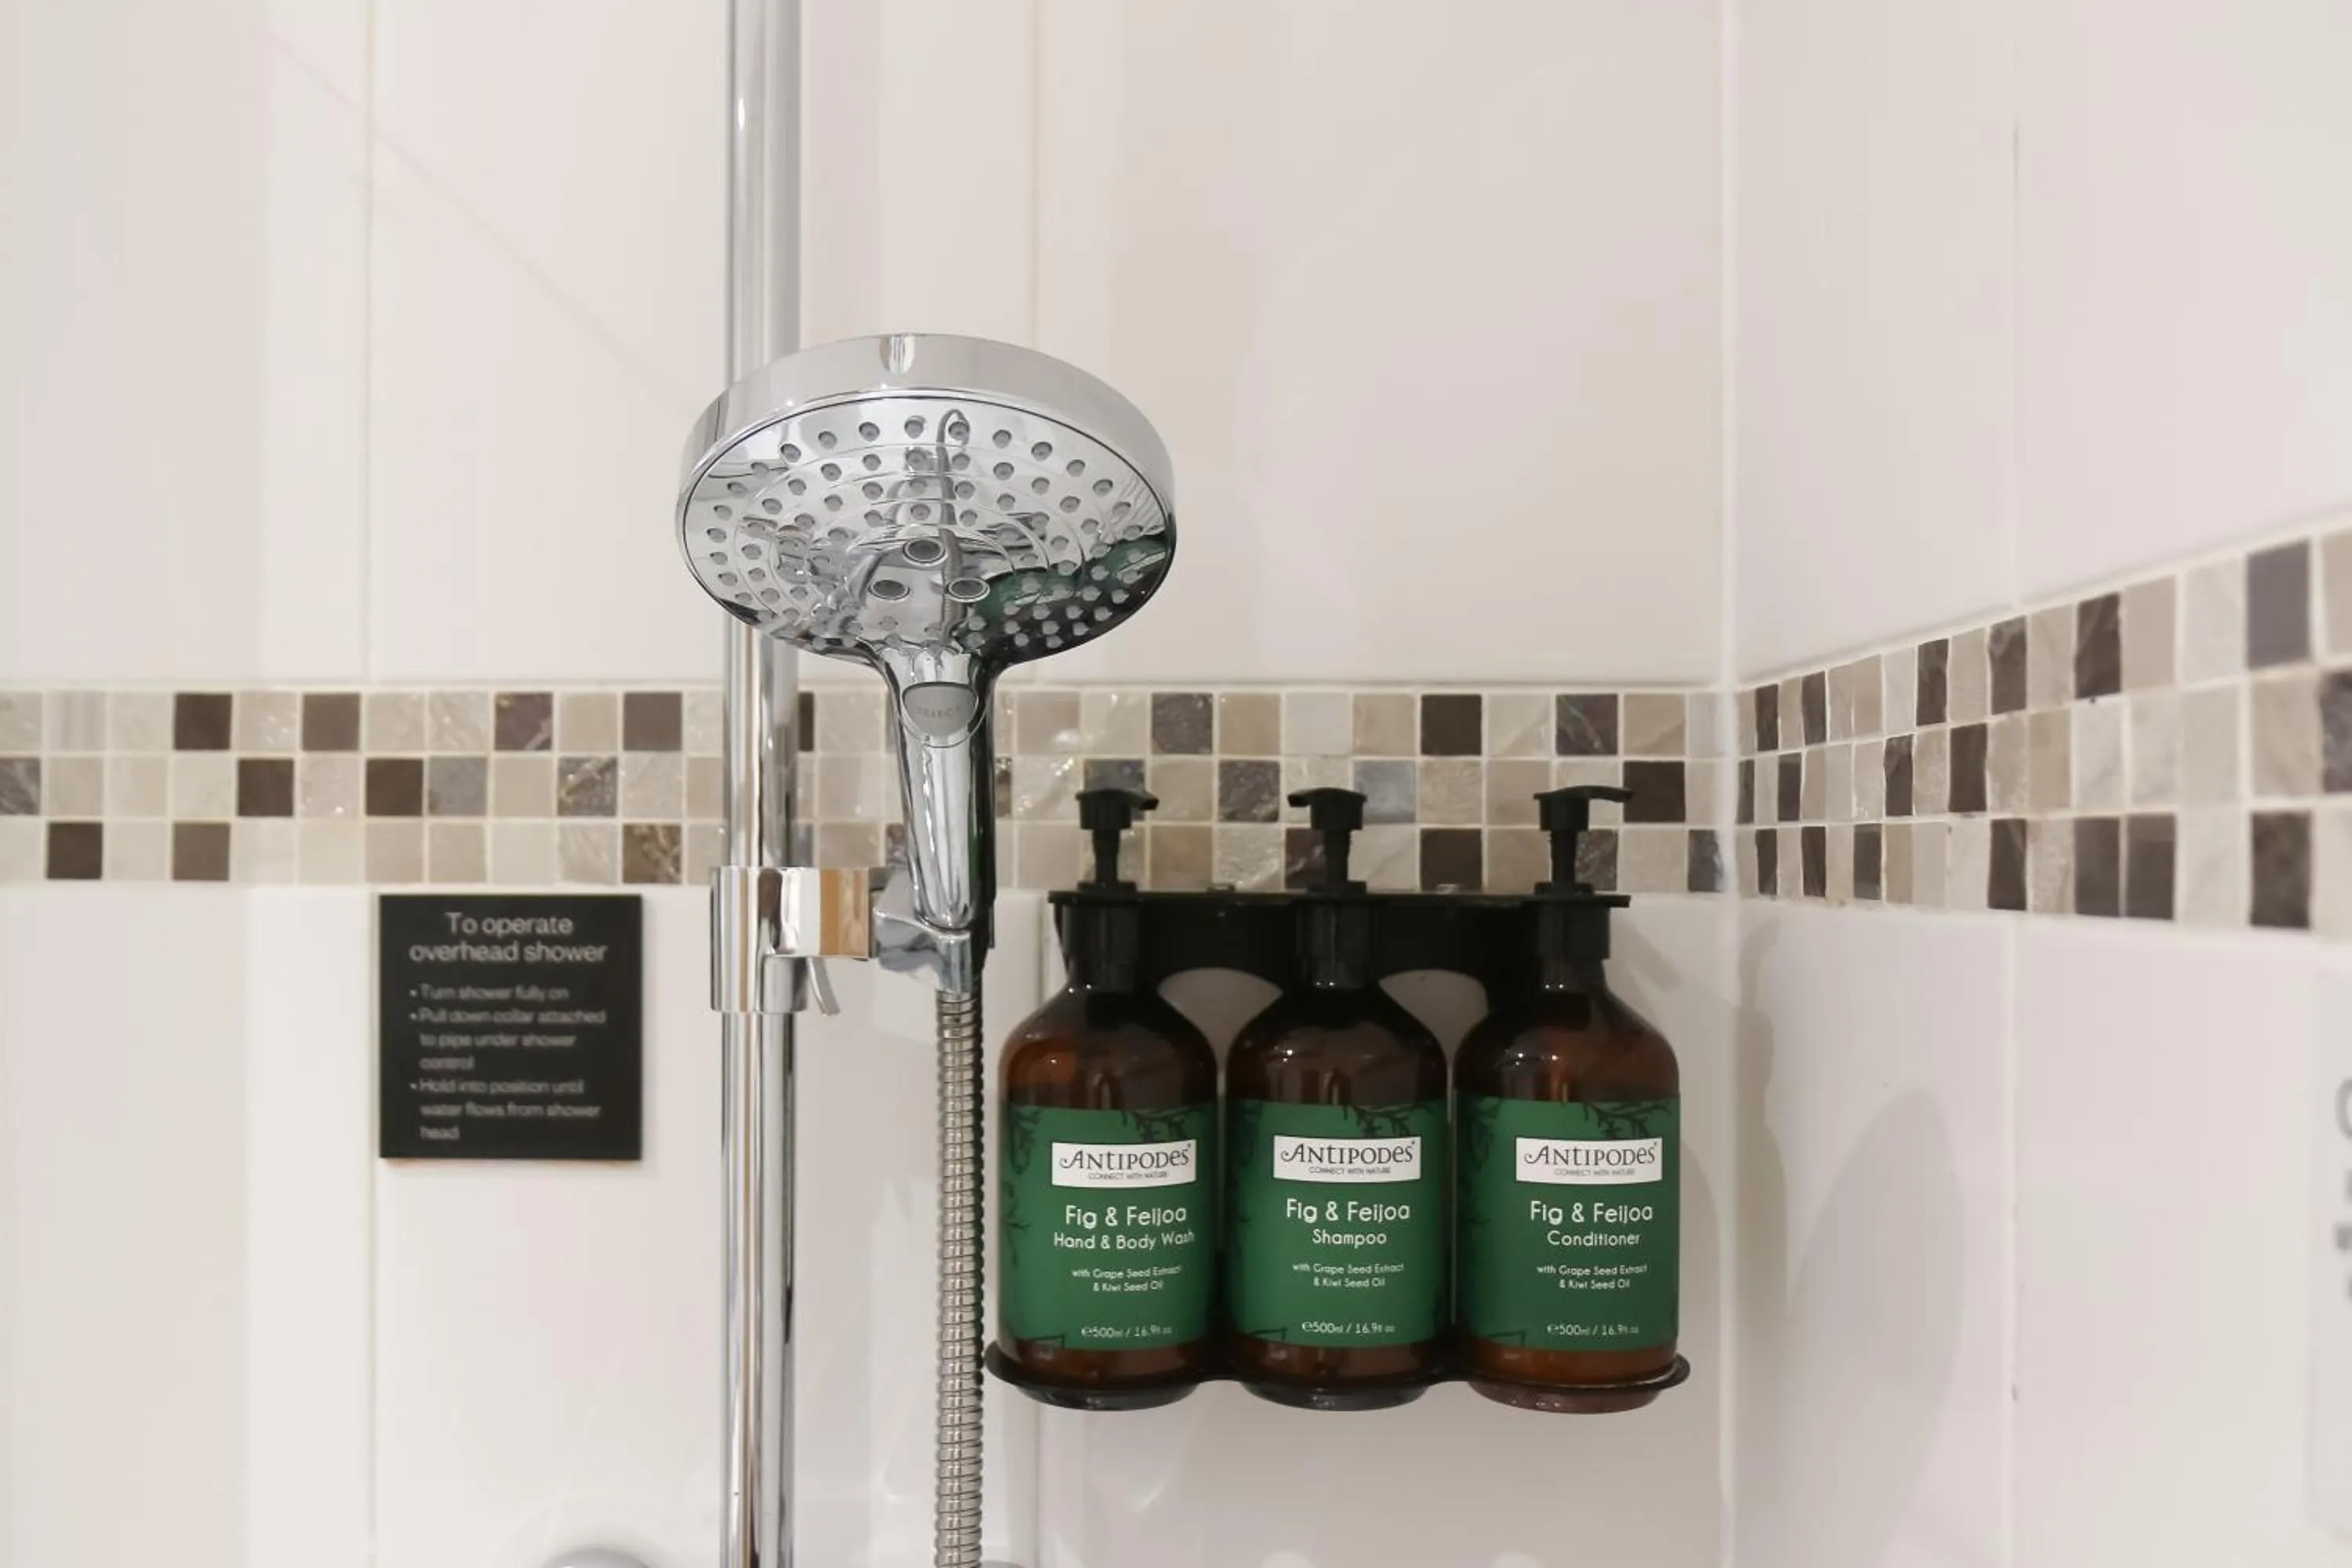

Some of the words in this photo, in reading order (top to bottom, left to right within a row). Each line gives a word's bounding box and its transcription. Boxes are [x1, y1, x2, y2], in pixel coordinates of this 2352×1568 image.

[445, 911, 477, 934] To
[481, 916, 574, 938] operate
[408, 942, 519, 962] overhead
[523, 942, 608, 962] shower
[419, 983, 455, 1000] Turn
[458, 985, 511, 1000] shower
[514, 985, 546, 1002] fully
[549, 989, 570, 1000] on
[418, 1007, 446, 1023] Pull
[449, 1010, 491, 1023] down
[493, 1008, 535, 1023] collar
[538, 1009, 607, 1024] attached
[419, 1033, 436, 1046] to
[438, 1035, 472, 1049] pipe
[474, 1033, 517, 1046] under
[521, 1033, 576, 1046] shower
[419, 1080, 456, 1093] Hold
[459, 1080, 487, 1093] into
[489, 1080, 550, 1095] position
[552, 1079, 584, 1093] until
[419, 1105, 461, 1116] water
[465, 1102, 504, 1116] flows
[506, 1102, 544, 1116] from
[547, 1102, 601, 1116] shower
[419, 1126, 459, 1140] head
[1065, 1204, 1098, 1229] Fig
[1105, 1206, 1118, 1227] &
[1127, 1205, 1186, 1227] Feijoa
[1286, 1197, 1318, 1223] Fig
[1326, 1200, 1339, 1221] &
[1348, 1200, 1410, 1223] Feijoa
[1530, 1200, 1563, 1225] Fig
[1571, 1202, 1584, 1223] &
[1593, 1202, 1653, 1225] Feijoa
[1054, 1232, 1095, 1249] Hand
[1100, 1235, 1110, 1249] &
[1116, 1233, 1156, 1250] Body
[1160, 1229, 1195, 1246] Wash
[1312, 1229, 1387, 1249] Shampoo
[1547, 1229, 1641, 1247] Conditioner
[1072, 1269, 1091, 1278] with
[1092, 1268, 1124, 1279] Grape
[1127, 1268, 1151, 1278] Seed
[1292, 1263, 1311, 1272] with
[1313, 1263, 1345, 1276] Grape
[1347, 1263, 1371, 1274] Seed
[1374, 1263, 1404, 1273] Extract
[1537, 1265, 1556, 1275] with
[1558, 1265, 1591, 1278] Grape
[1593, 1265, 1618, 1276] Seed
[1102, 1283, 1122, 1292] Kiwi
[1123, 1281, 1149, 1292] Seed
[1150, 1279, 1164, 1290] Oil
[1323, 1277, 1341, 1287] Kiwi
[1344, 1277, 1370, 1287] Seed
[1371, 1276, 1385, 1287] Oil
[1569, 1279, 1588, 1290] Kiwi
[1591, 1279, 1616, 1290] Seed
[1617, 1279, 1631, 1289] Oil
